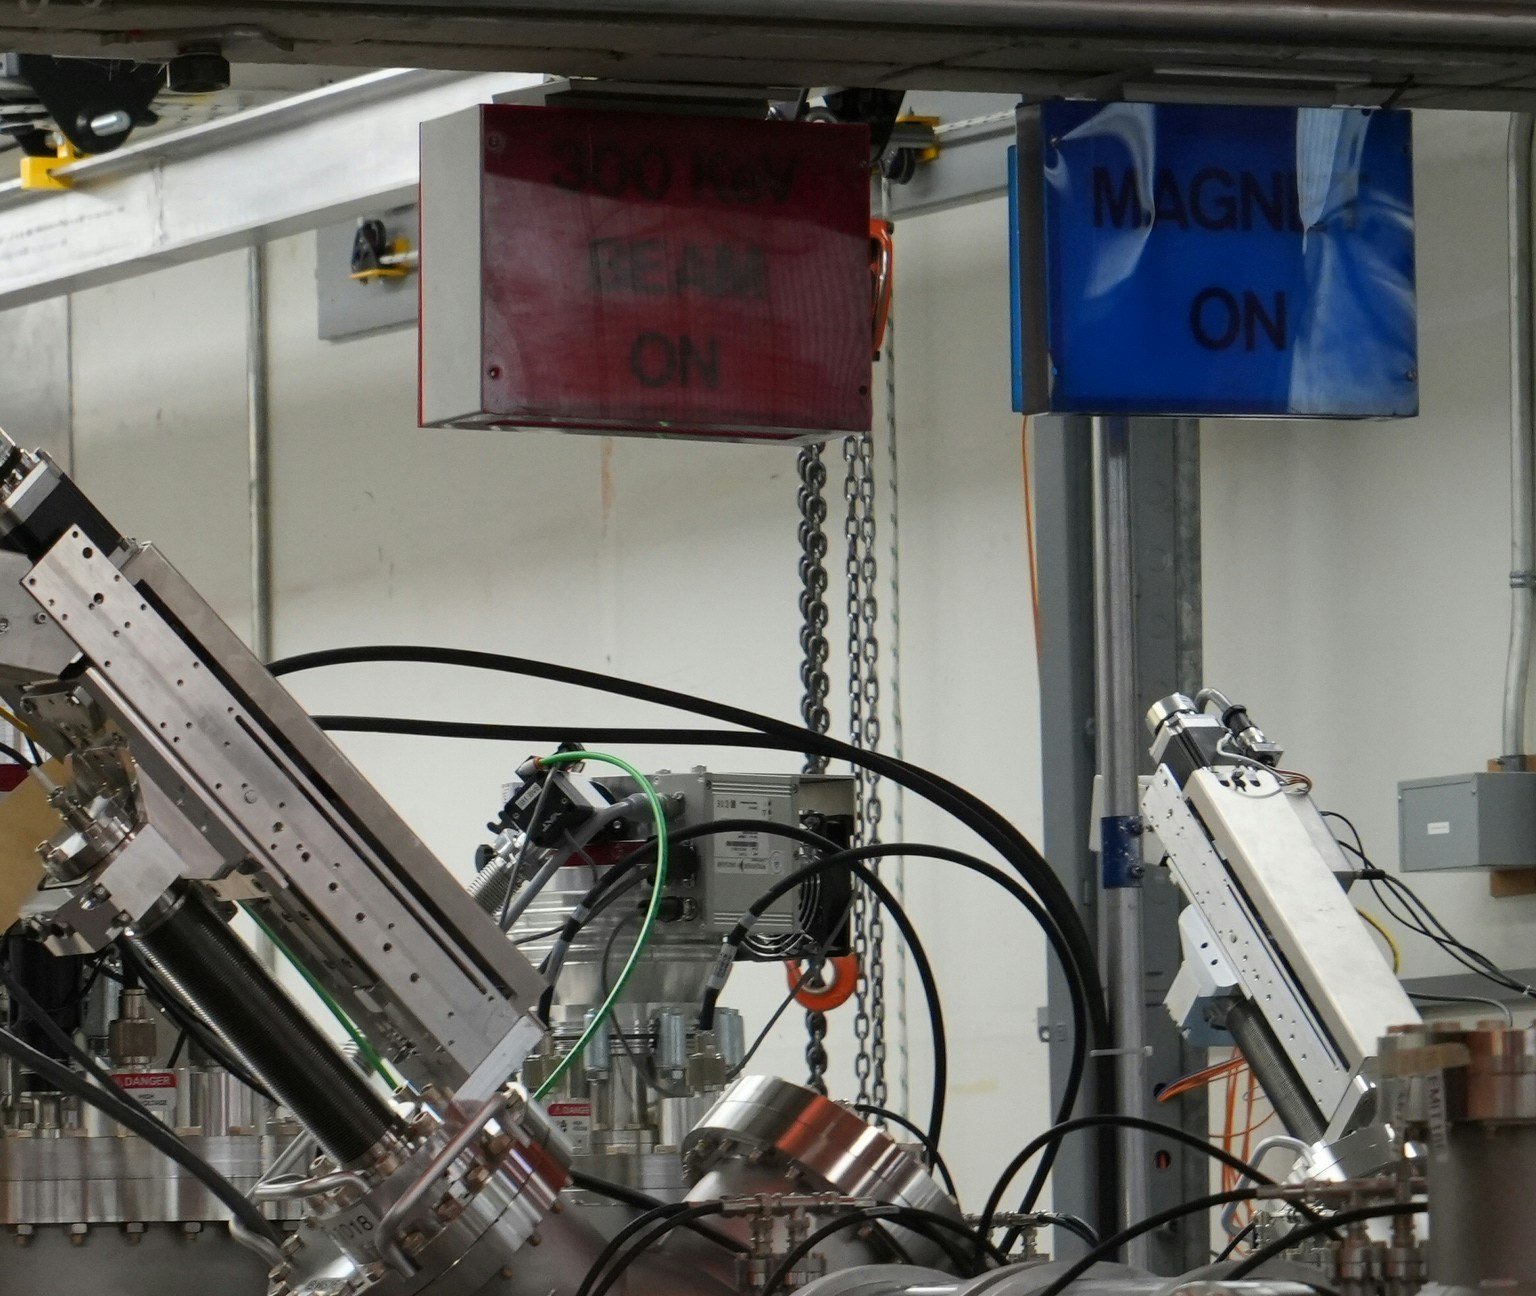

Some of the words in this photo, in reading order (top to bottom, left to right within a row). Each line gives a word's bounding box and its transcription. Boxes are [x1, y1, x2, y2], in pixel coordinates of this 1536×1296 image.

[550, 140, 673, 200] 300
[589, 236, 766, 299] BEAM
[1190, 287, 1288, 352] ON
[630, 329, 721, 389] ON
[124, 1076, 171, 1087] DANGER
